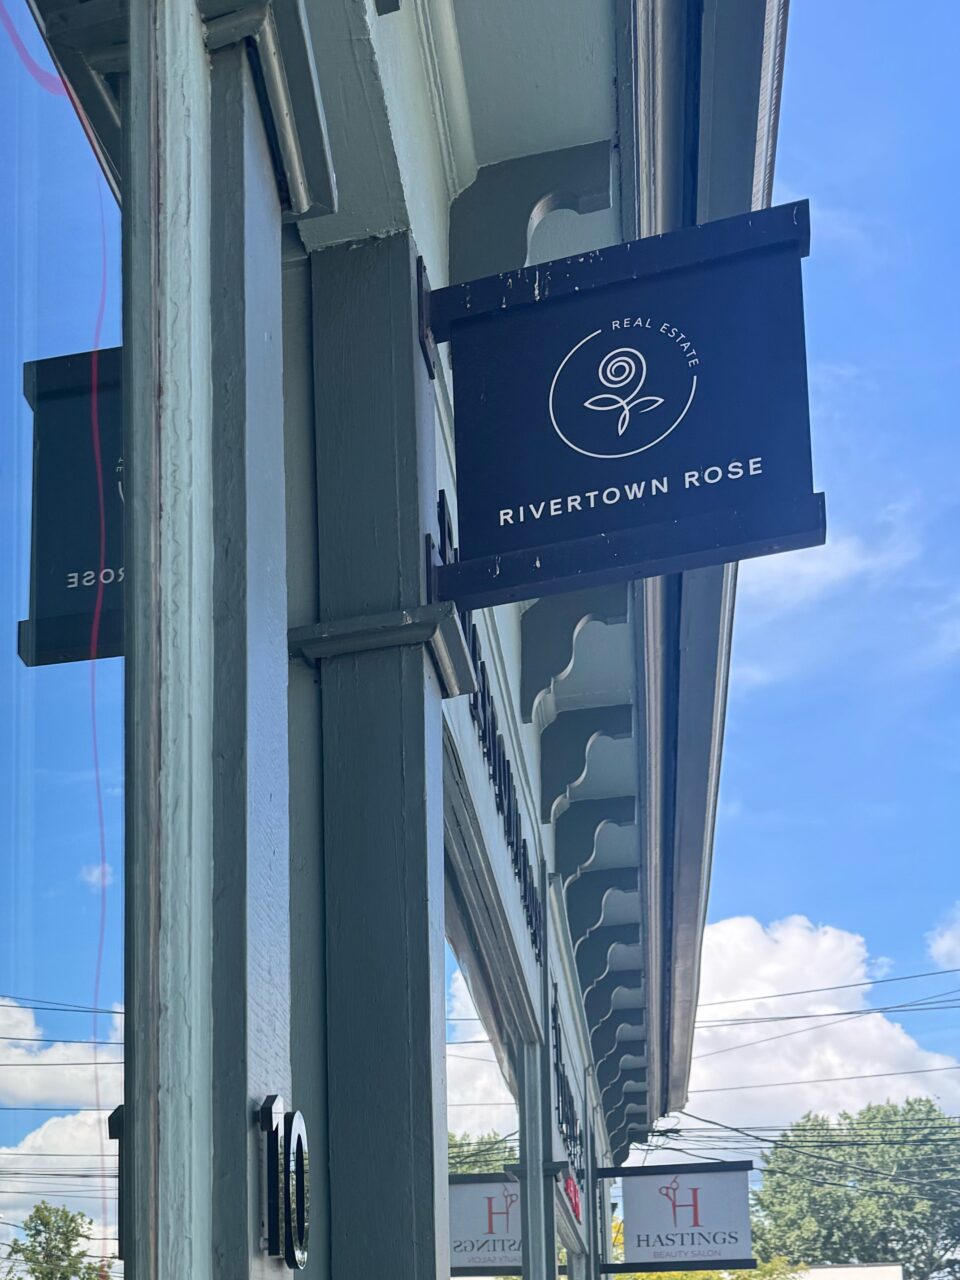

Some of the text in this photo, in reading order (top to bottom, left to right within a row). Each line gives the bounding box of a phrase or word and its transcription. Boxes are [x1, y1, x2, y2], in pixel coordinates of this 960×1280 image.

[611, 316, 700, 369] REAL ESTATE
[498, 456, 765, 527] RIVERTOWN ROSE
[260, 1094, 310, 1270] 10
[635, 1230, 739, 1248] HASTINGS
[653, 1249, 722, 1259] BEAUTY SALON
